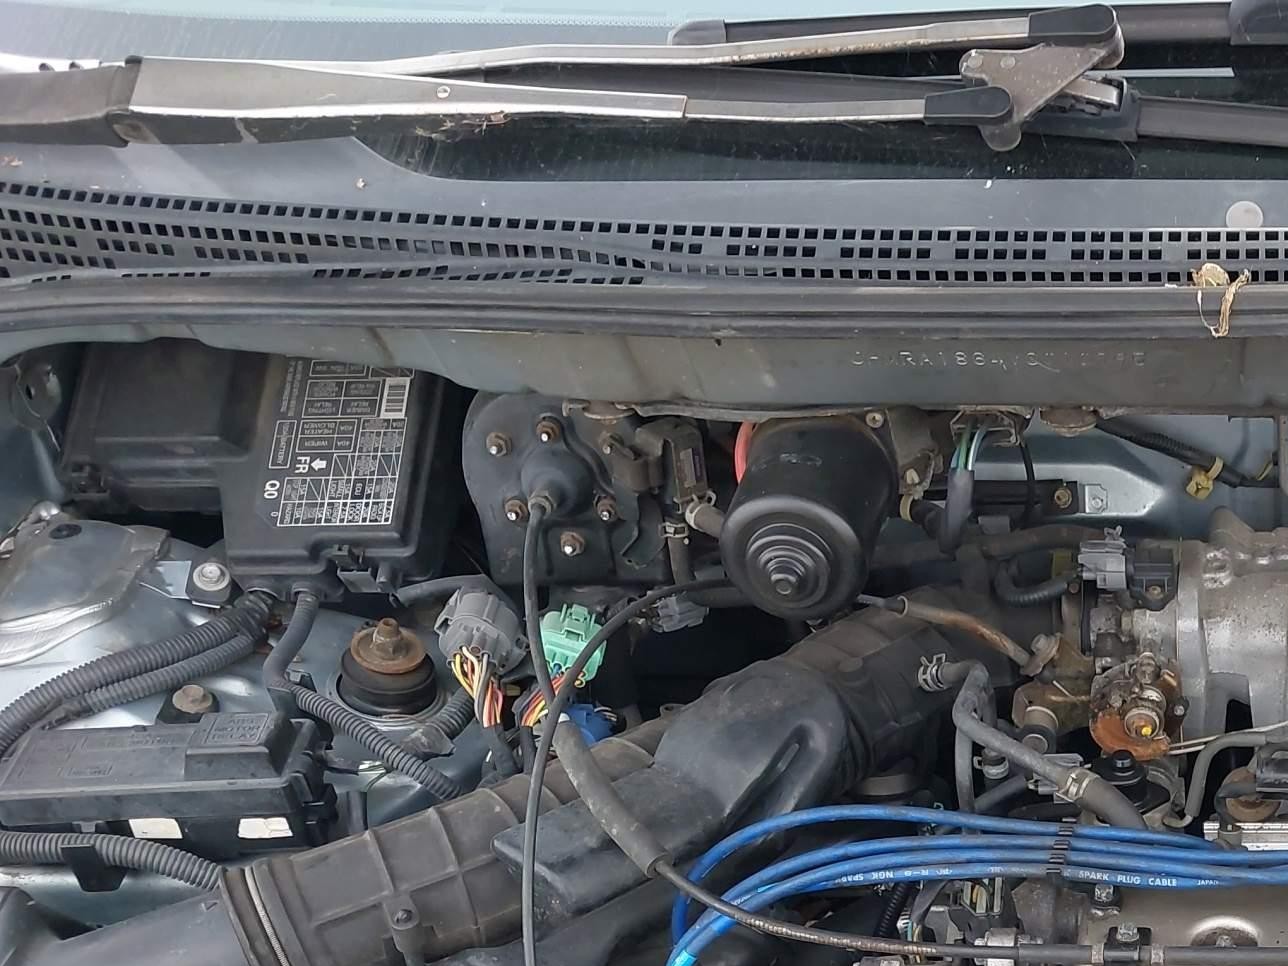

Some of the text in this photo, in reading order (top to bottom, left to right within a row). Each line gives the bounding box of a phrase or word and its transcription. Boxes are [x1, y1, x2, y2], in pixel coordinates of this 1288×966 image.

[295, 456, 310, 473] FR
[354, 483, 362, 496] ECU
[871, 871, 894, 879] NGK
[1079, 871, 1109, 881] SPARK
[1117, 874, 1141, 885] PLUG
[1148, 877, 1177, 887] CABLE
